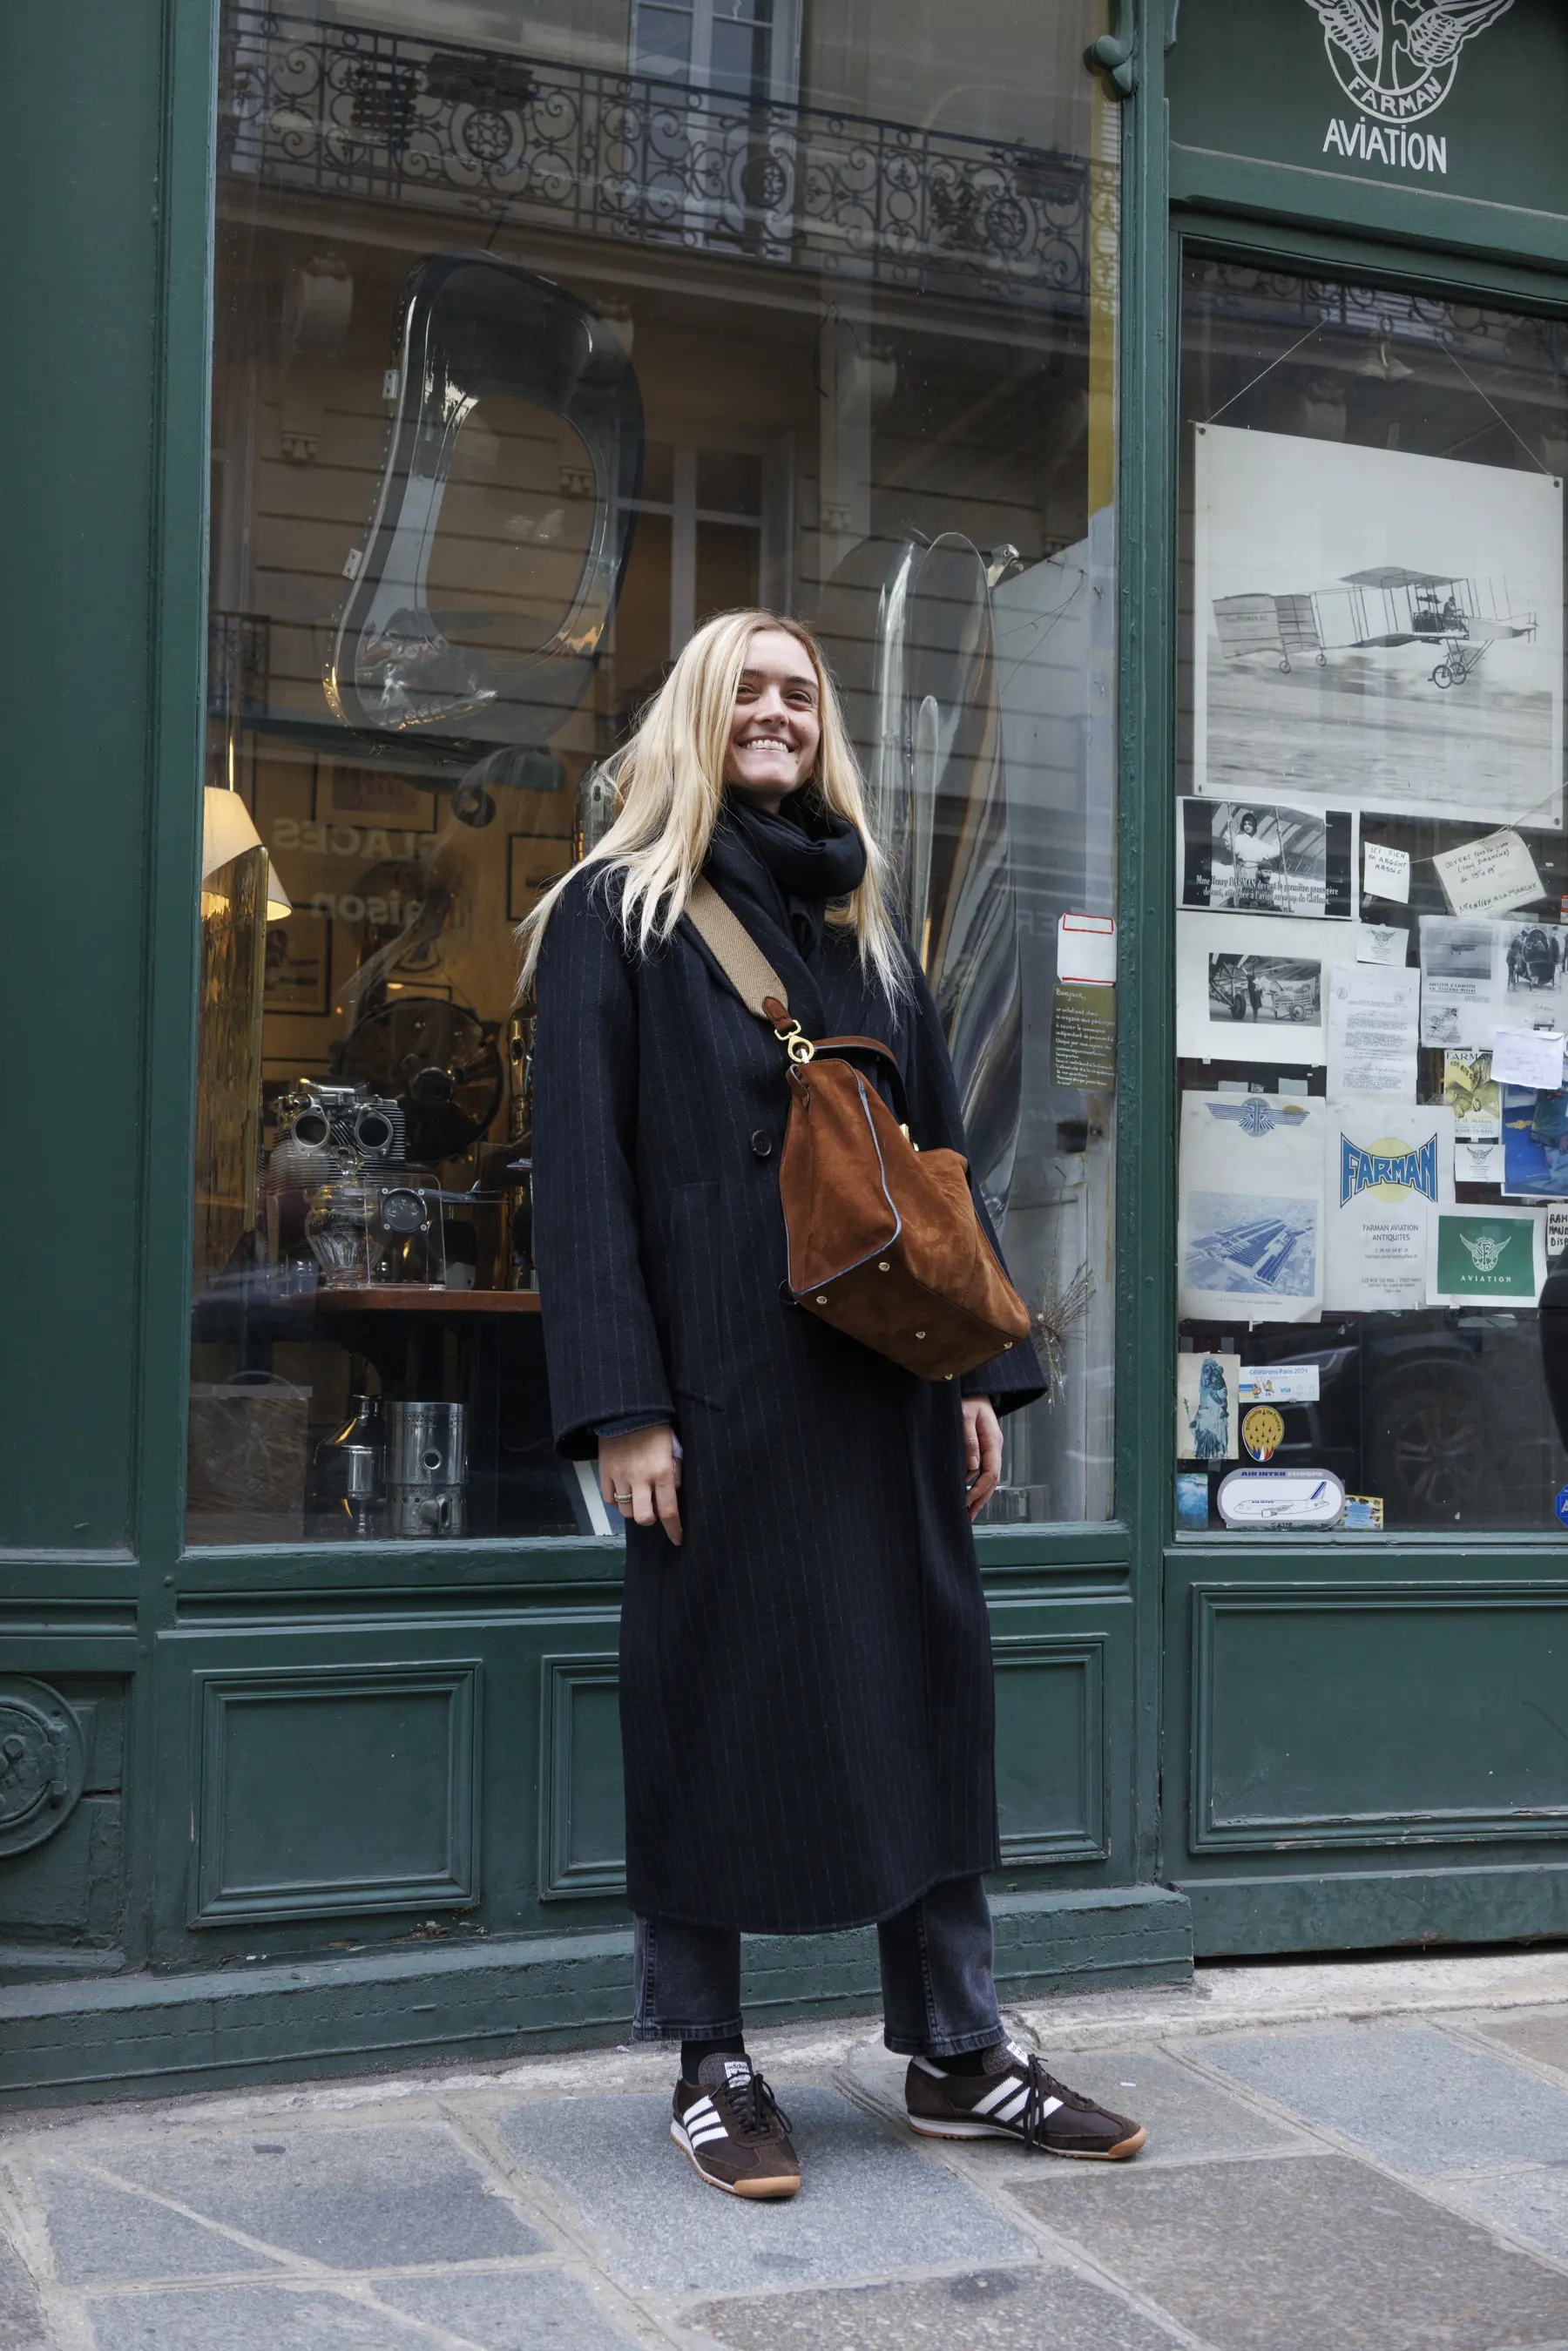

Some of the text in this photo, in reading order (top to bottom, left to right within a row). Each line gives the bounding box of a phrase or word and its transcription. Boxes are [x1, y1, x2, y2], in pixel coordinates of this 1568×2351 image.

[1348, 76, 1443, 117] FARMAN
[1388, 849, 1405, 859] RIEN
[1196, 875, 1211, 886] Mme
[1340, 1132, 1438, 1209] FARMAN
[1460, 1274, 1511, 1283] AVIATION
[1246, 1409, 1262, 1430] patrouille
